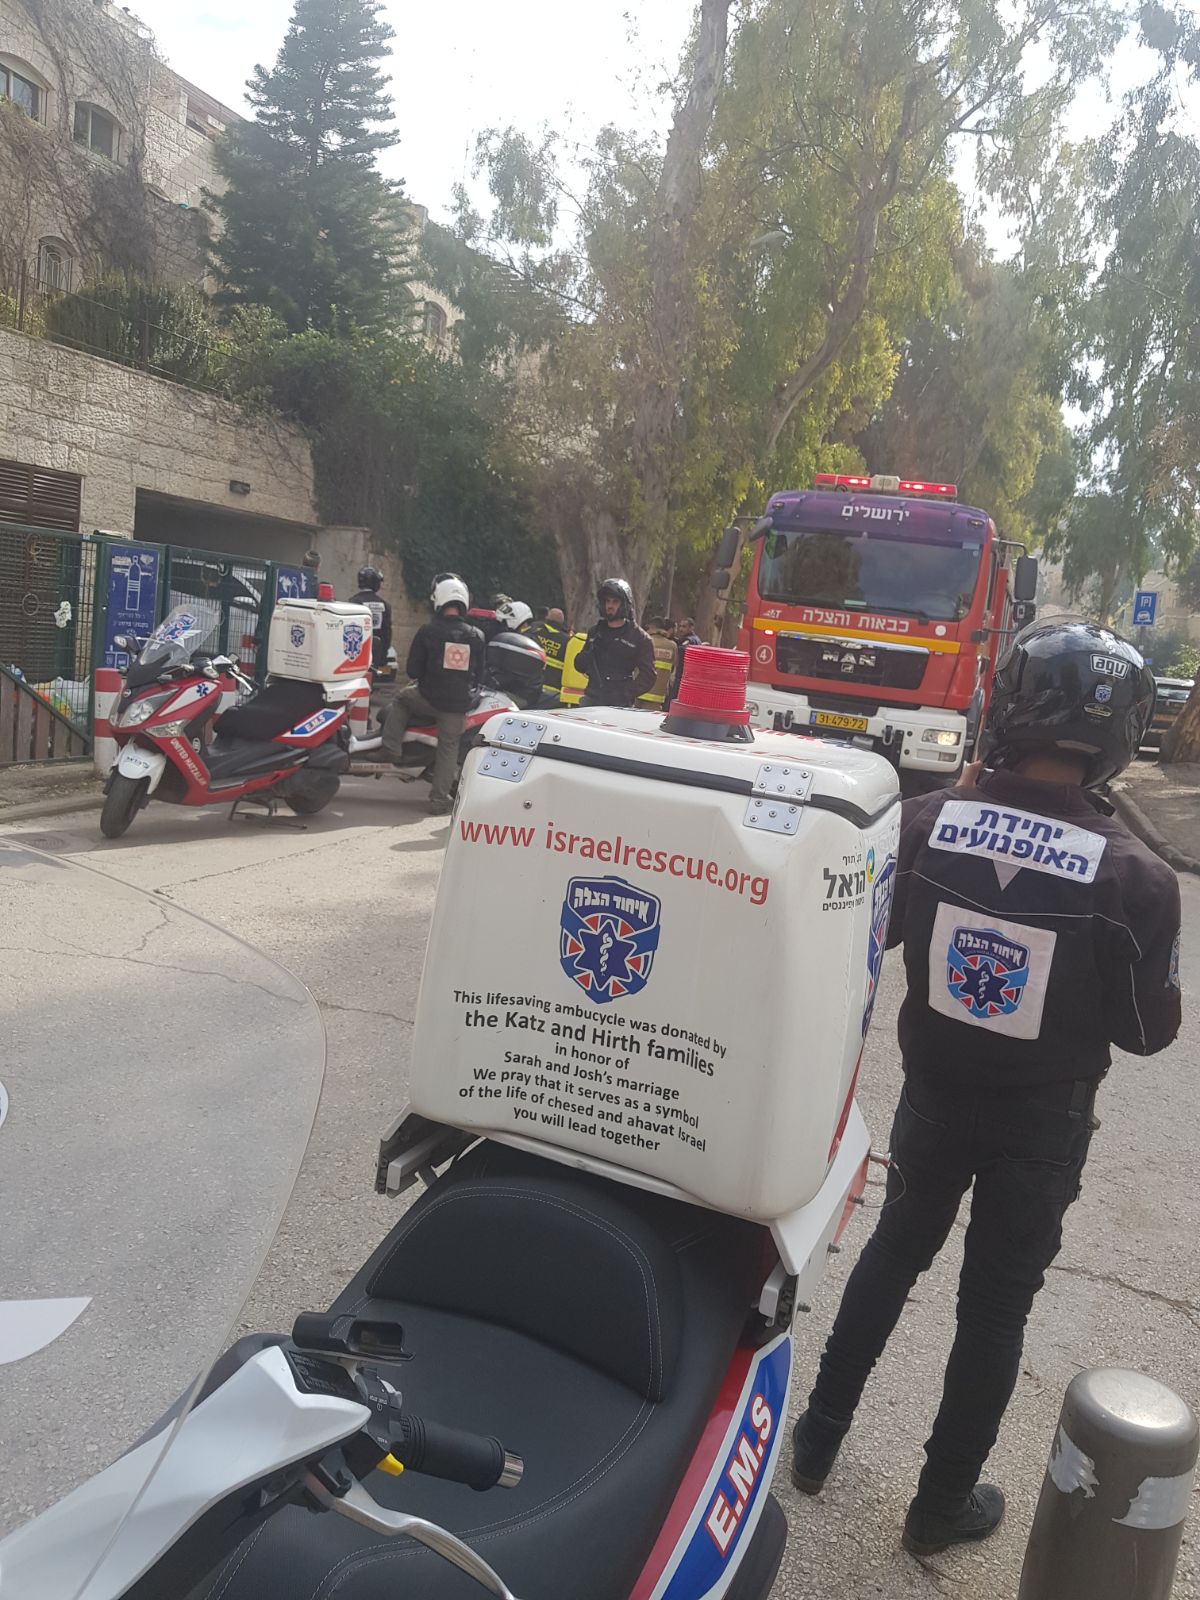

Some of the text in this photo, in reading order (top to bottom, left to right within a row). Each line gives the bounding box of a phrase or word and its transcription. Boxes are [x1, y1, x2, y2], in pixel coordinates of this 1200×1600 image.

[841, 505, 910, 521] ירושלים
[802, 609, 851, 627] והצלה
[858, 615, 910, 633] כבאות
[758, 648, 768, 661] 4
[822, 650, 877, 668] MAN
[819, 713, 865, 730] 31-479-72
[170, 738, 189, 760] UNITED
[974, 809, 1064, 843] יחידת
[460, 820, 770, 905] www israelrescue.org
[936, 824, 1090, 876] האופנועים
[823, 867, 866, 899] הראל
[573, 886, 650, 924] איחוד הצלה
[957, 932, 989, 950] הצלה
[991, 941, 1023, 967] איחוד
[453, 990, 727, 1058] This lifesaving ambucycle was donated by
[465, 1010, 715, 1076] the Katz and Hirth families
[555, 1042, 631, 1070] in honor of
[504, 1051, 542, 1068] Sarah
[546, 1061, 570, 1075] and
[616, 1077, 680, 1100] marriage
[473, 1068, 699, 1129] We pray that it serves as a symbol
[459, 1085, 706, 1152] of the life of chesed and ahavat Israel
[513, 1107, 661, 1151] you will lead together
[706, 1395, 772, 1554] E.M.S
